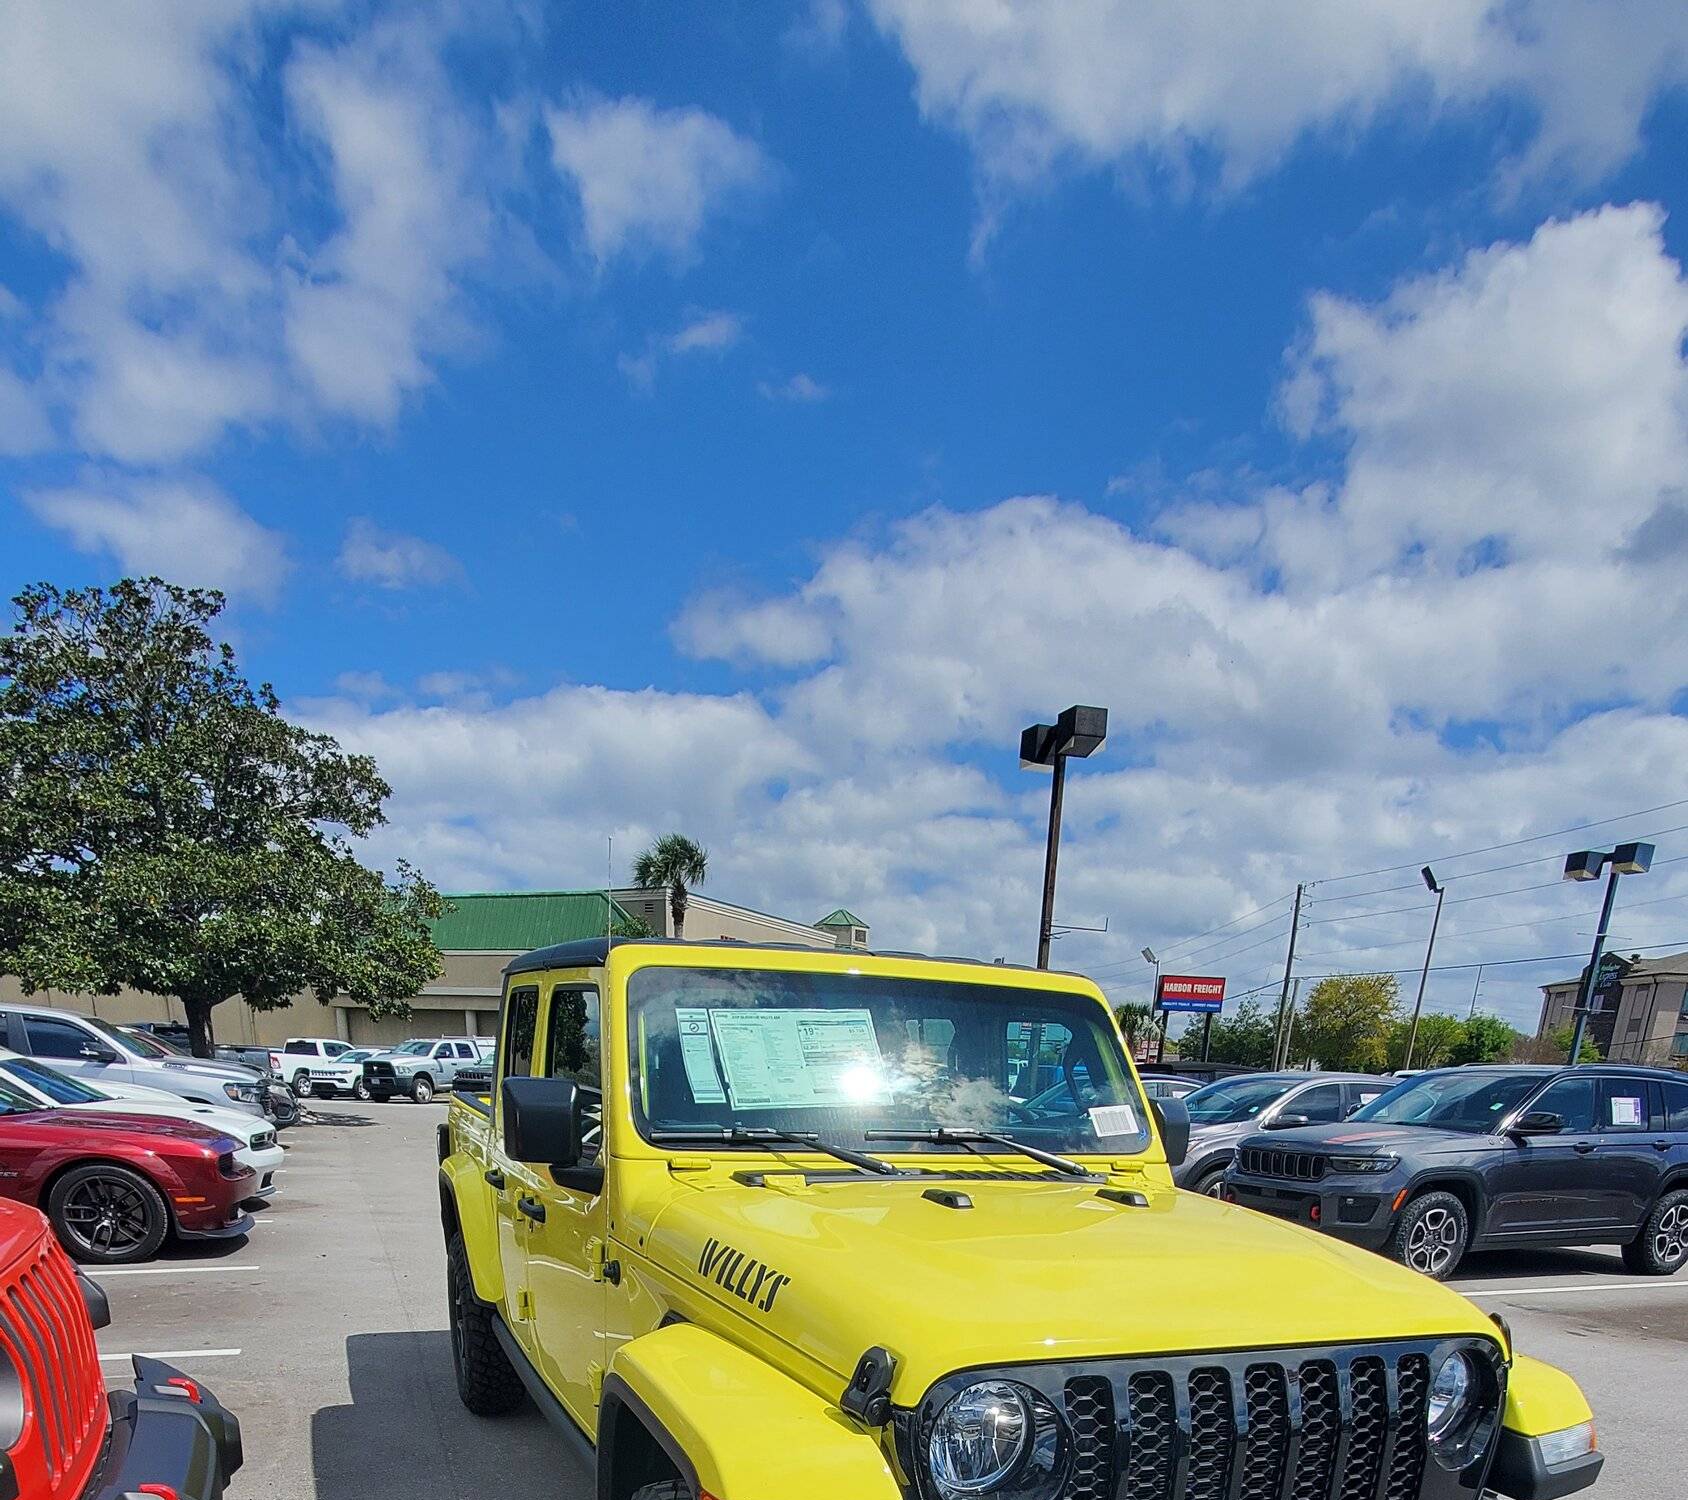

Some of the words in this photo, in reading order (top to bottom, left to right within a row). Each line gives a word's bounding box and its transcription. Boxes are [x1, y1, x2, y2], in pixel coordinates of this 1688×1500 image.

[1163, 983, 1192, 993] HARBOR
[1193, 984, 1223, 994] FREIGHT
[697, 1237, 792, 1313] WILLYS
